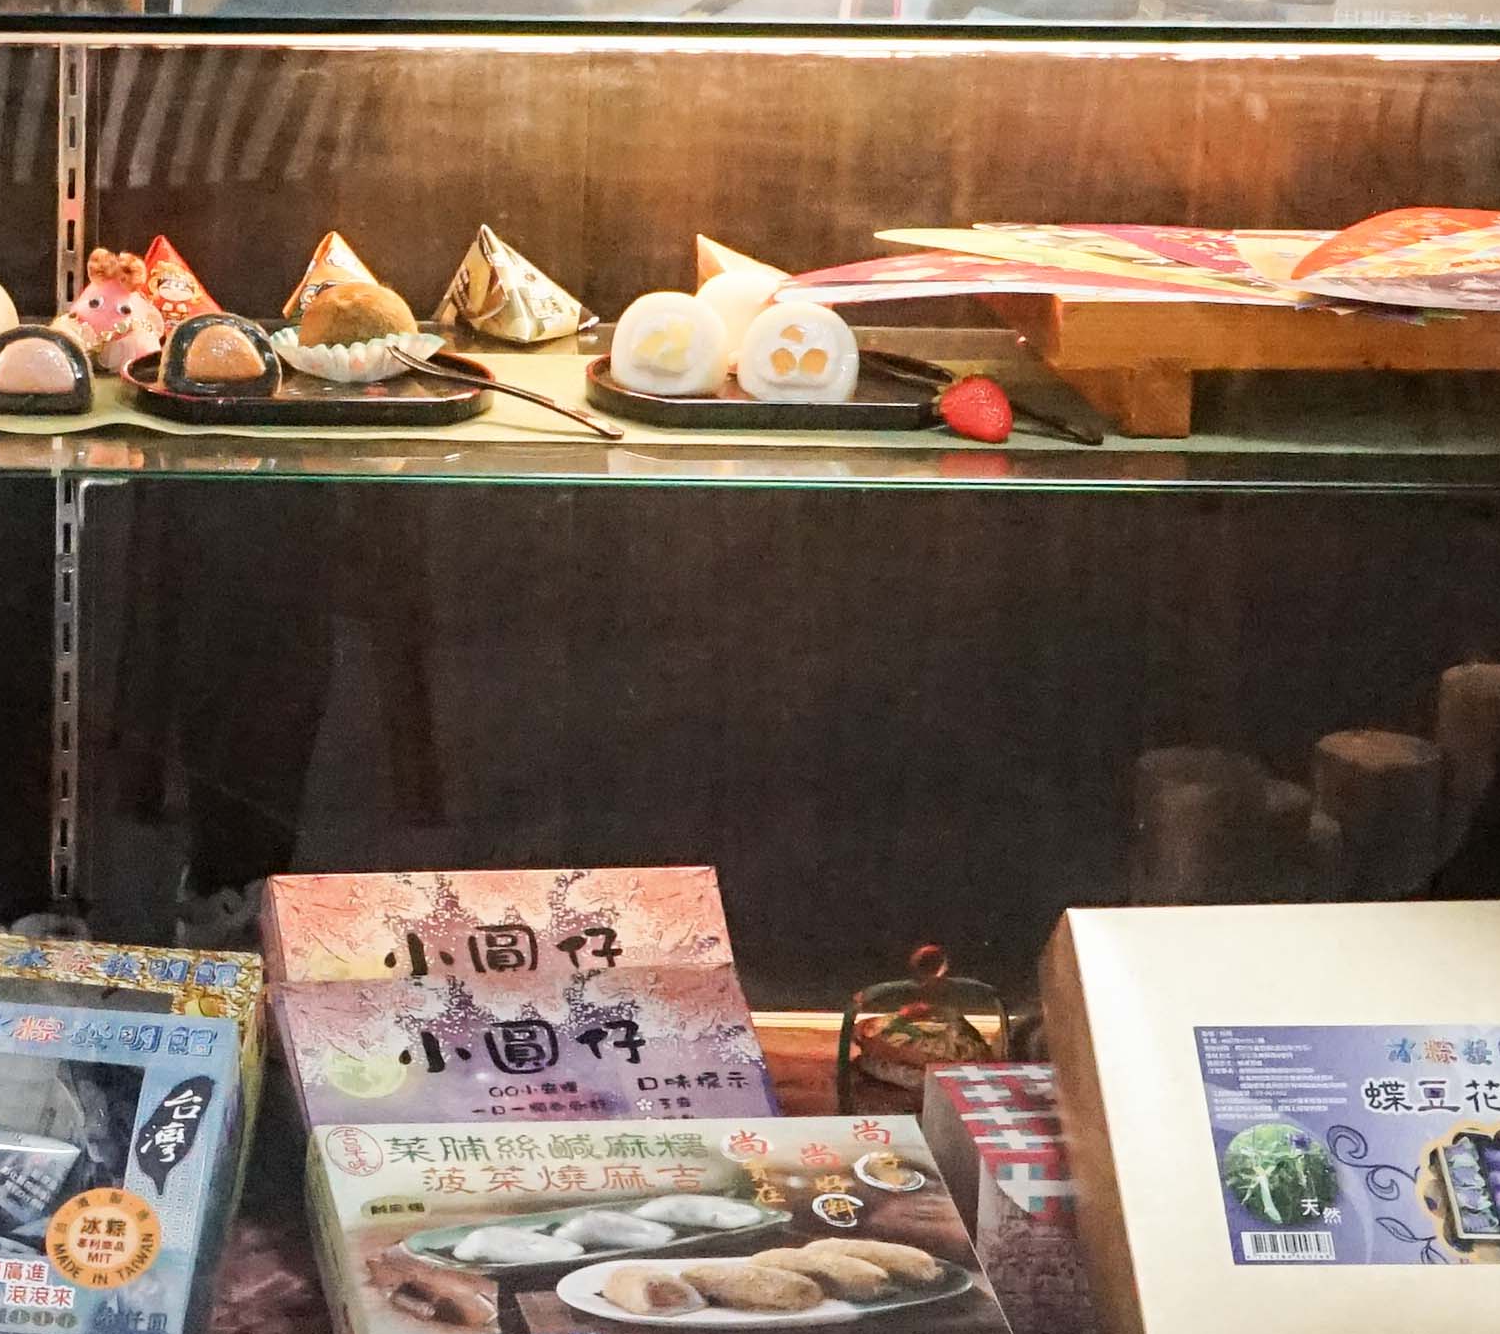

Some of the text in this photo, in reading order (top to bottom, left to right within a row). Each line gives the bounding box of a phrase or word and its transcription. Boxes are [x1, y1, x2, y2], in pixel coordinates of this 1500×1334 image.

[384, 924, 624, 976] 小圓仔
[398, 1019, 647, 1075] 小圓仔
[140, 1088, 204, 1163] 台灣
[383, 1132, 710, 1164] 菜脯絲鹹麻糬
[422, 1163, 708, 1195] 菠菜燒麻吉
[1300, 1197, 1342, 1224] 天然
[53, 1243, 83, 1279] MADE
[92, 1272, 109, 1285] IN
[87, 1252, 113, 1264] MIT
